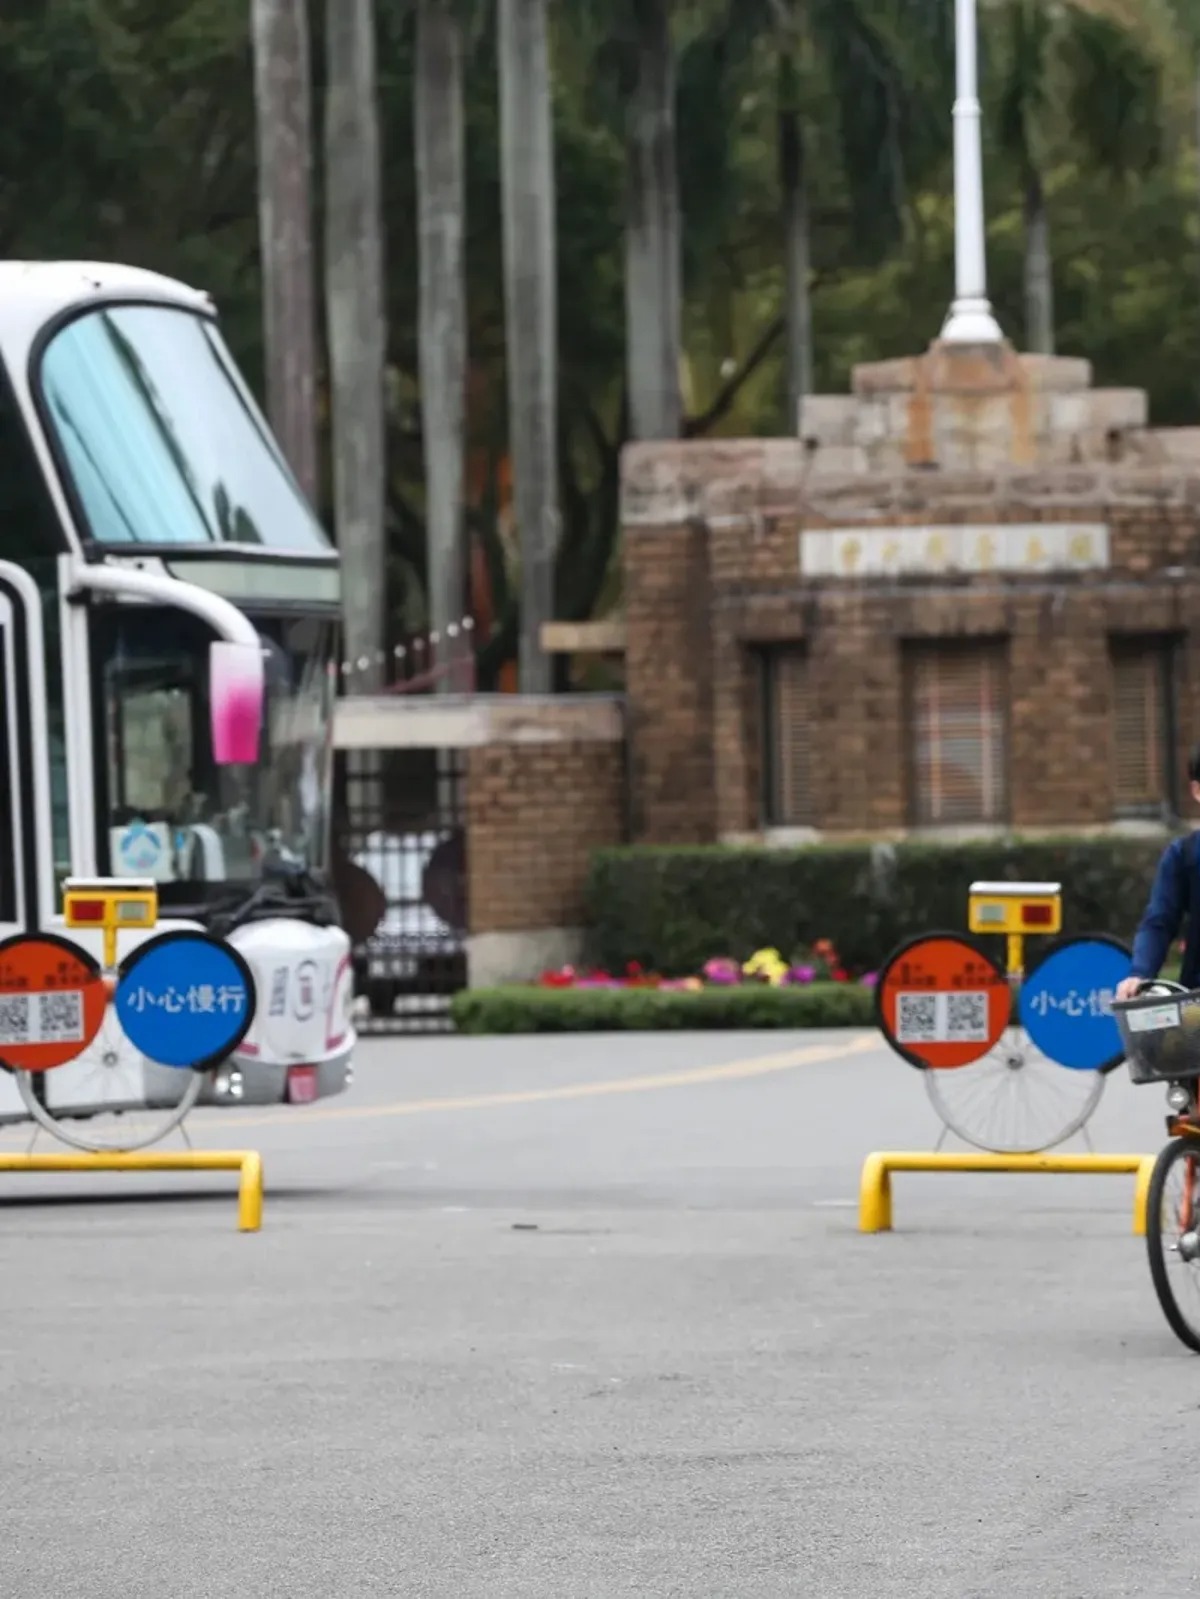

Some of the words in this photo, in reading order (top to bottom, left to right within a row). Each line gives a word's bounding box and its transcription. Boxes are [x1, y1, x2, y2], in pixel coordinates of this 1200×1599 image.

[127, 984, 246, 1013] 小心慢行
[1030, 987, 1116, 1017] 小心慢
